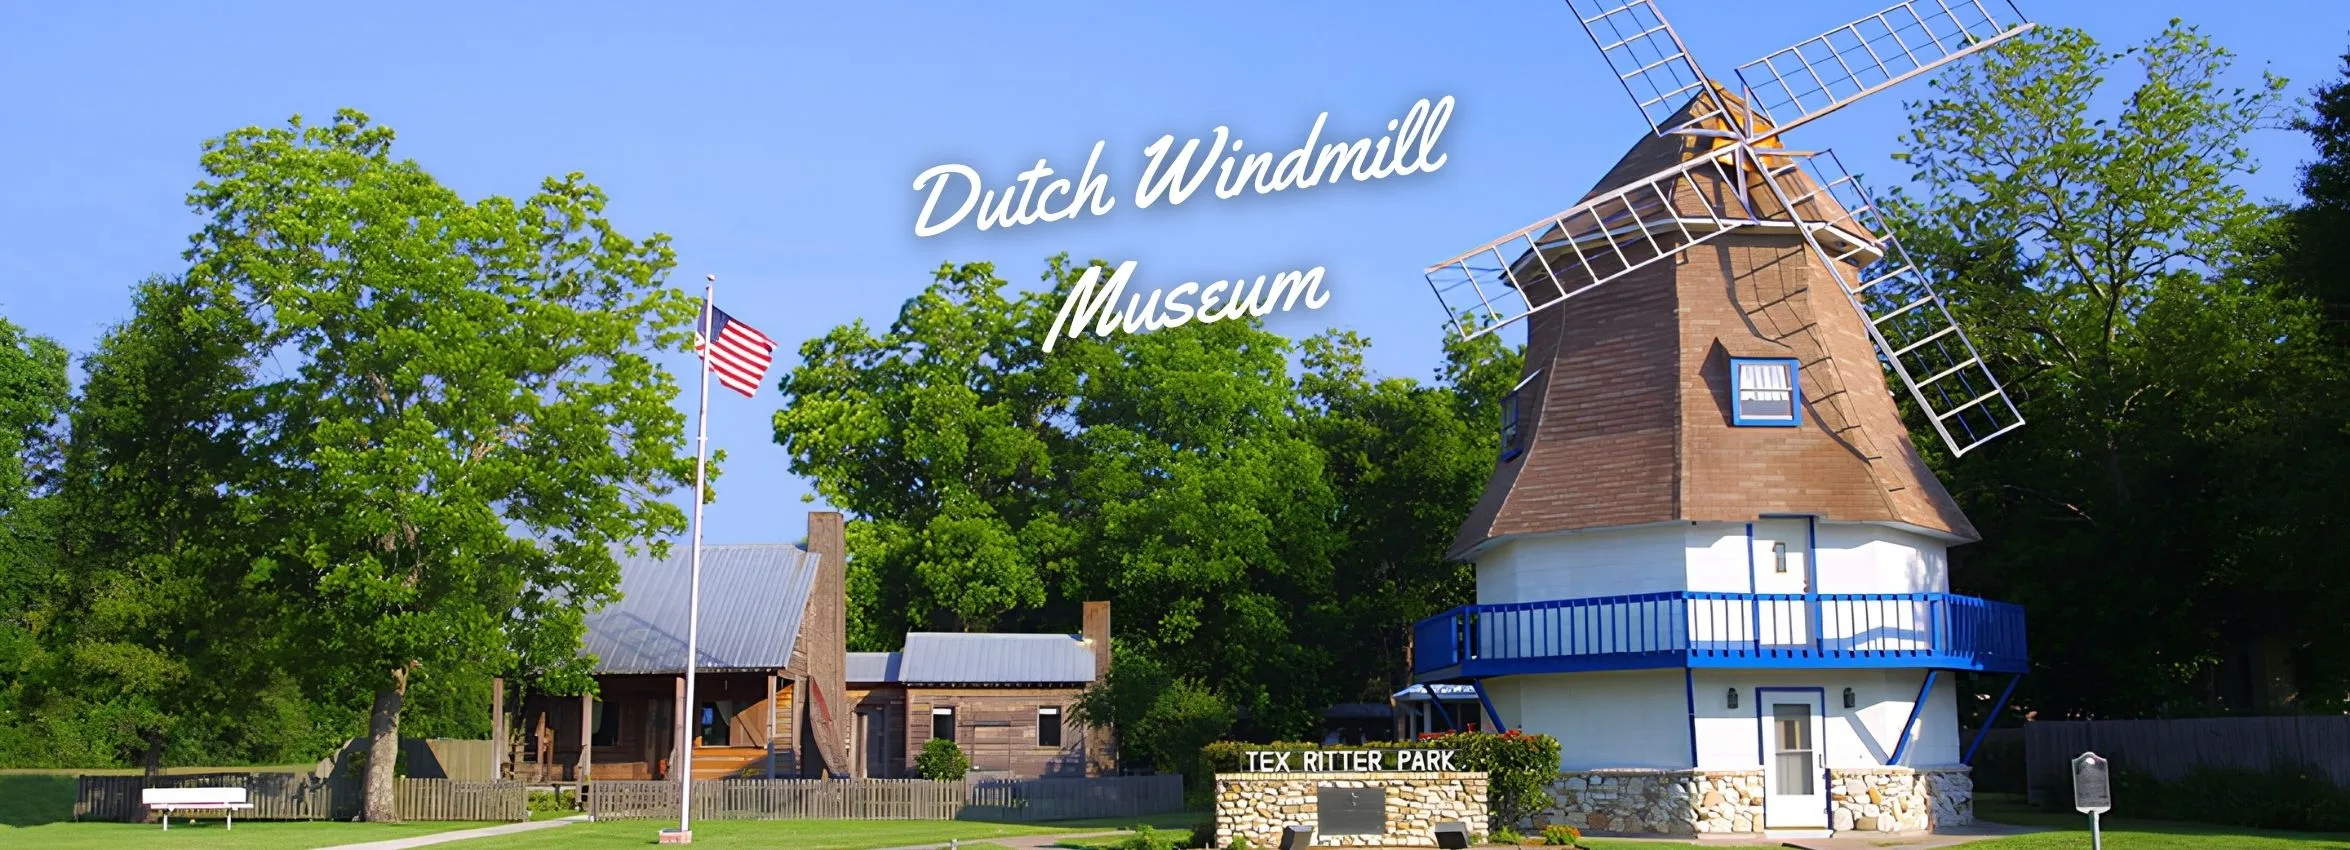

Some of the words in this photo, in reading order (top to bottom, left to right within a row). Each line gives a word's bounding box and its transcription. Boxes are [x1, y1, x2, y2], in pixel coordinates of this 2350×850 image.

[1245, 751, 1291, 773] TEX
[1303, 750, 1383, 772] RITTER
[1397, 750, 1457, 771] PARK
